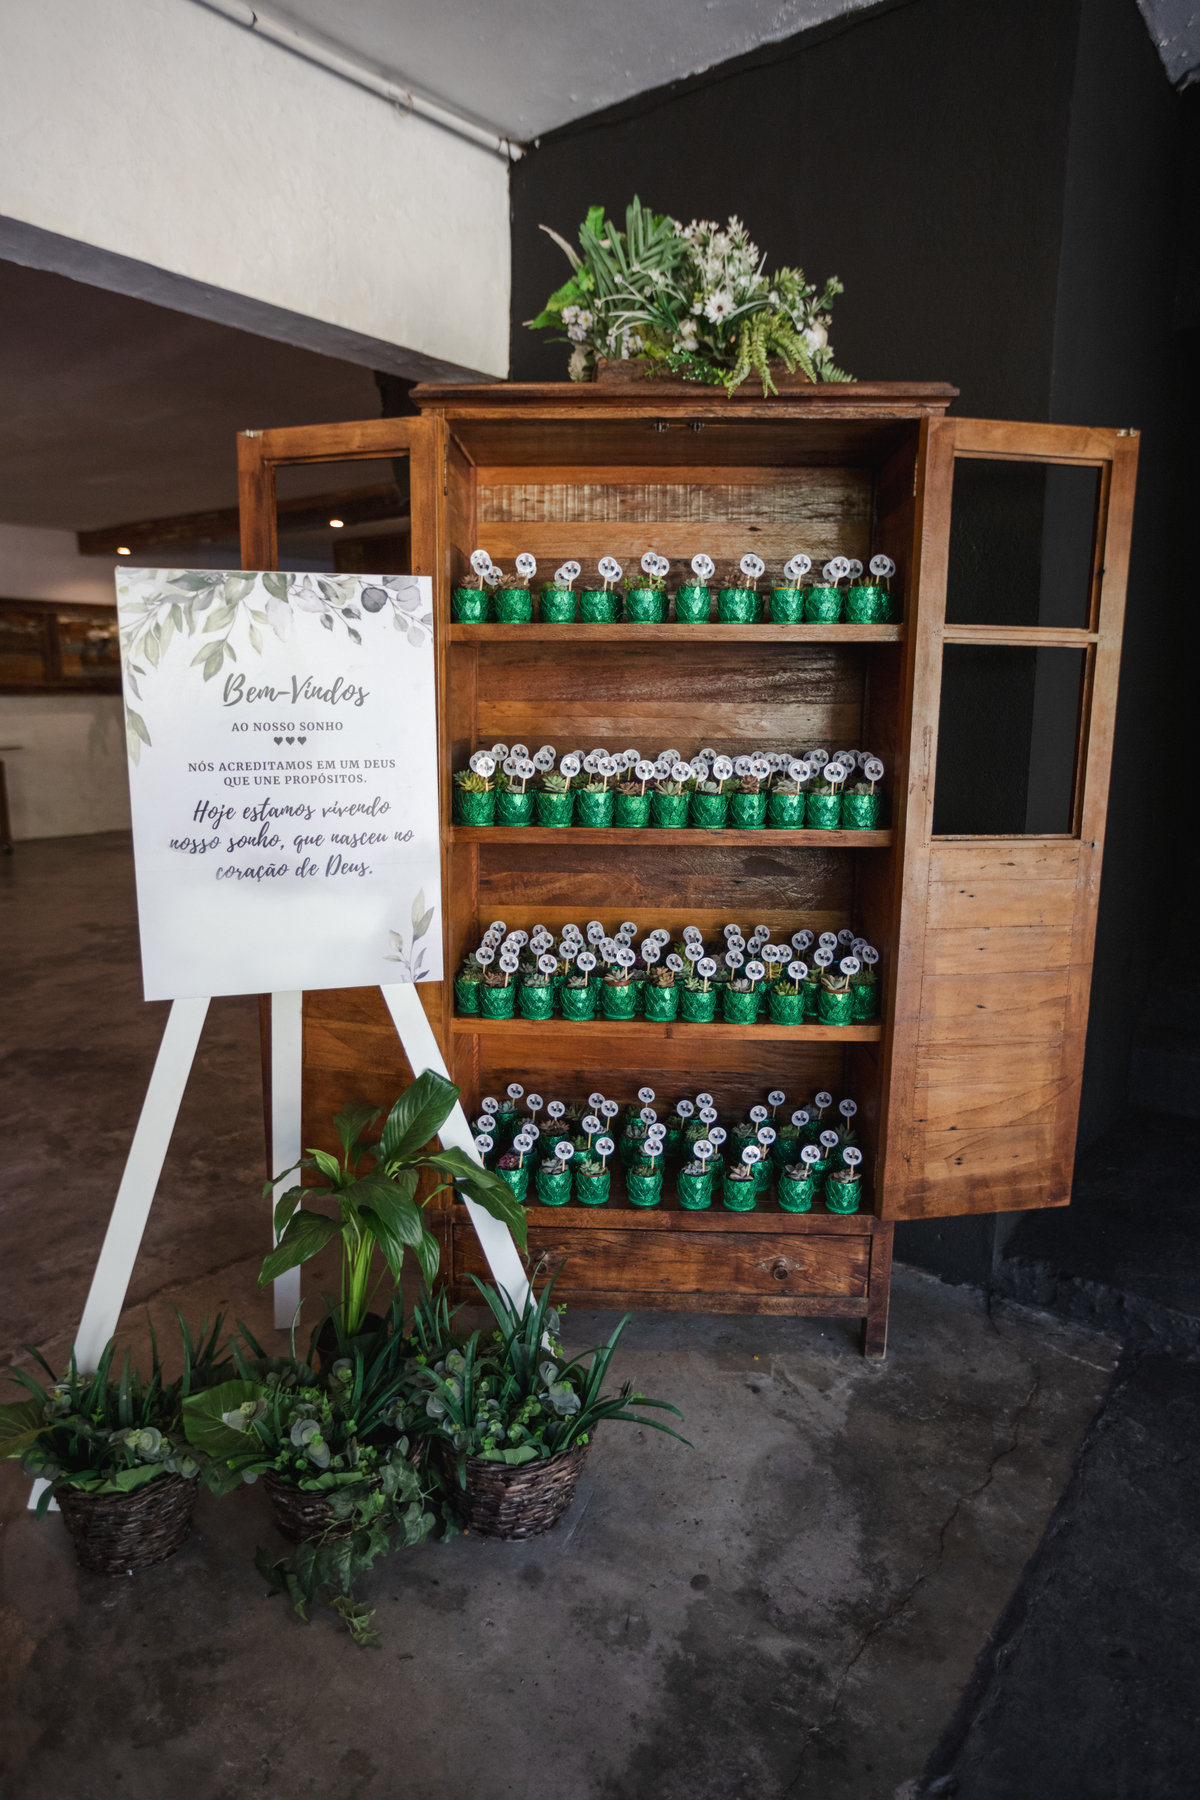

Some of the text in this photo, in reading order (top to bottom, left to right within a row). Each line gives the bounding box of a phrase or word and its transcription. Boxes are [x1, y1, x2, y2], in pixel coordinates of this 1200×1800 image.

[222, 672, 371, 708] Bem-Vindos
[231, 721, 344, 733] AO NOSSO SONHO
[187, 758, 396, 773] NÓS ACREDITAMOS EM UM DEUS
[223, 772, 367, 788] QUE UNE PROPÓSITOS.
[192, 795, 392, 831] Hoje estamos vivendo
[168, 820, 415, 855] nosso sonho, que nasceu no
[215, 853, 373, 883] coração de Deus.
